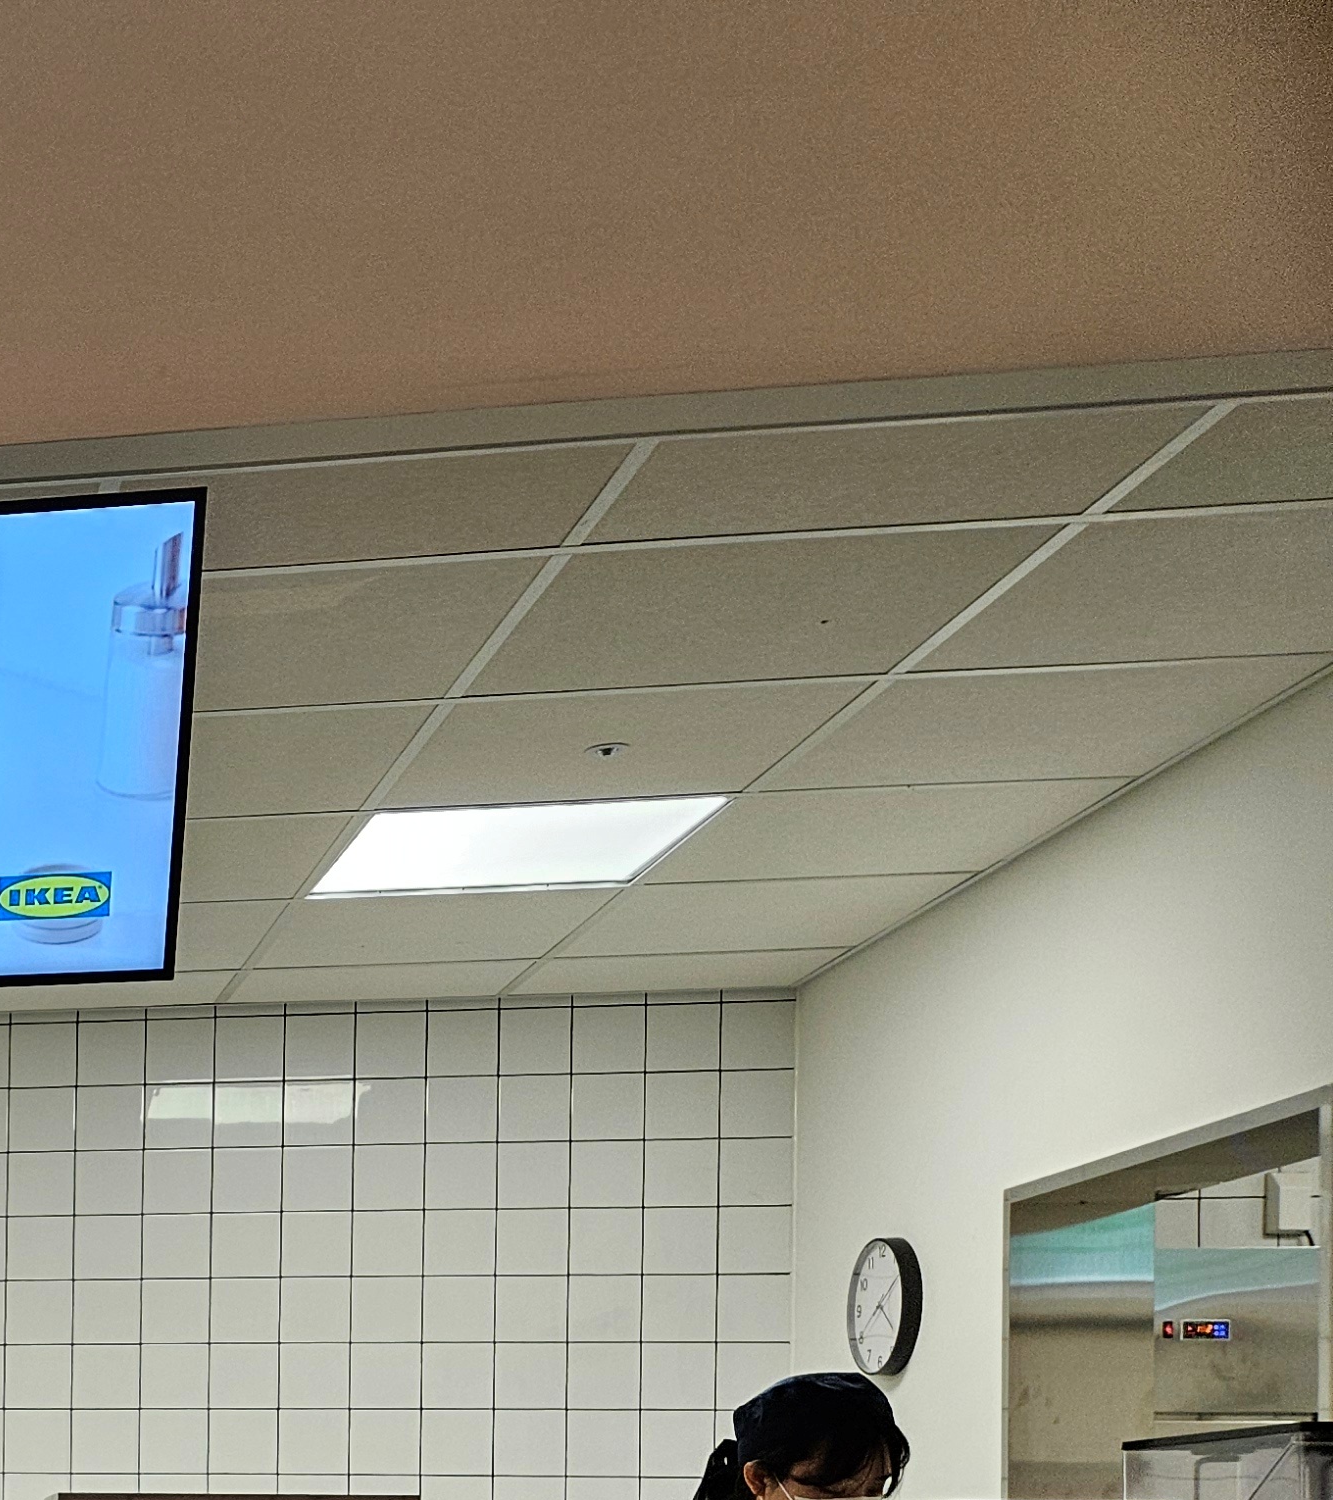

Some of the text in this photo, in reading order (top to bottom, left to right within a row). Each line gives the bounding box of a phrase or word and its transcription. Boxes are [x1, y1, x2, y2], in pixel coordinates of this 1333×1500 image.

[9, 886, 101, 907] IKEA
[878, 1244, 886, 1258] 12
[868, 1257, 874, 1270] 11
[860, 1278, 868, 1291] 10
[856, 1305, 862, 1318] 9
[858, 1331, 864, 1344] 8
[866, 1349, 872, 1363] 7
[877, 1355, 883, 1369] 6
